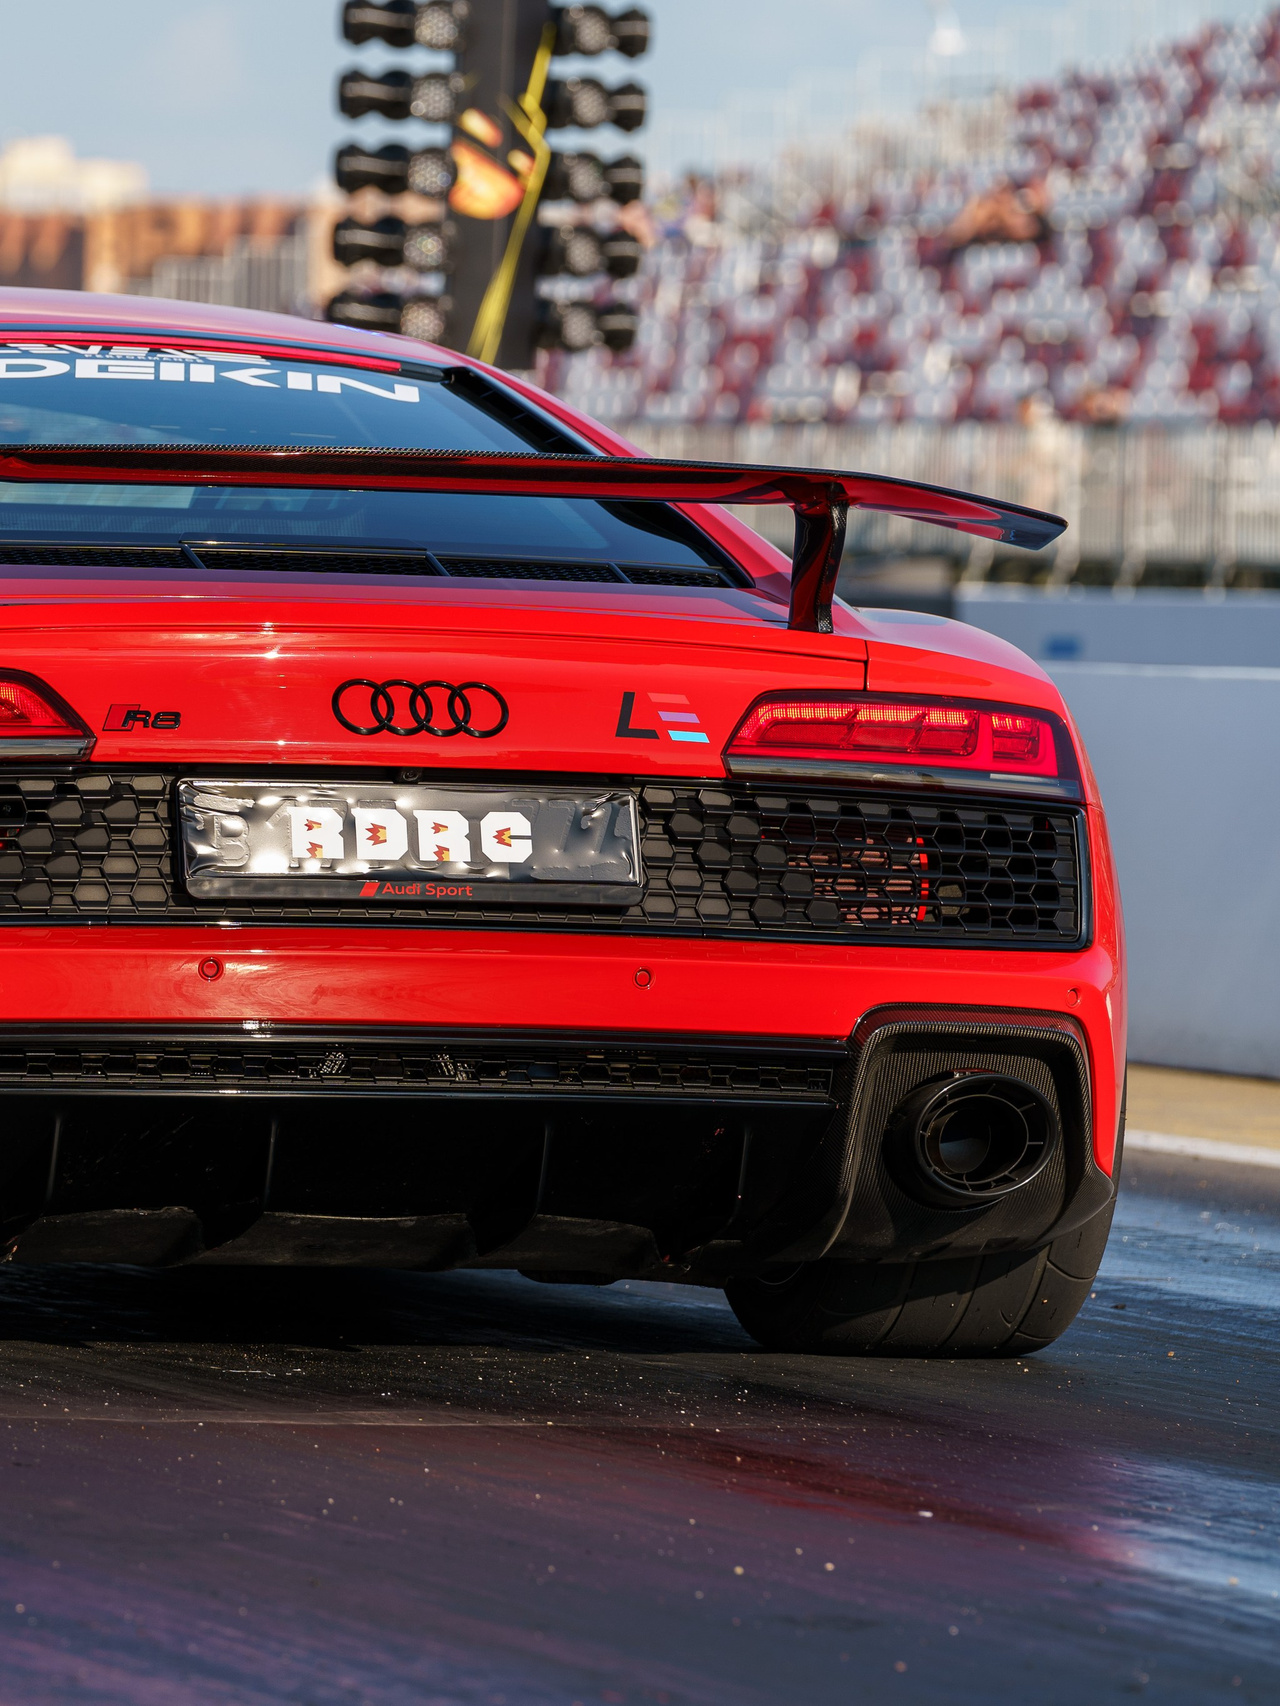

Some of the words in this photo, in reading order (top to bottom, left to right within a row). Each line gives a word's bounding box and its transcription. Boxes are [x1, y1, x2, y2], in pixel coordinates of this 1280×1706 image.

[121, 709, 181, 729] R8
[286, 806, 533, 863] RDRC
[382, 882, 421, 895] Audi
[425, 883, 473, 898] Sport
